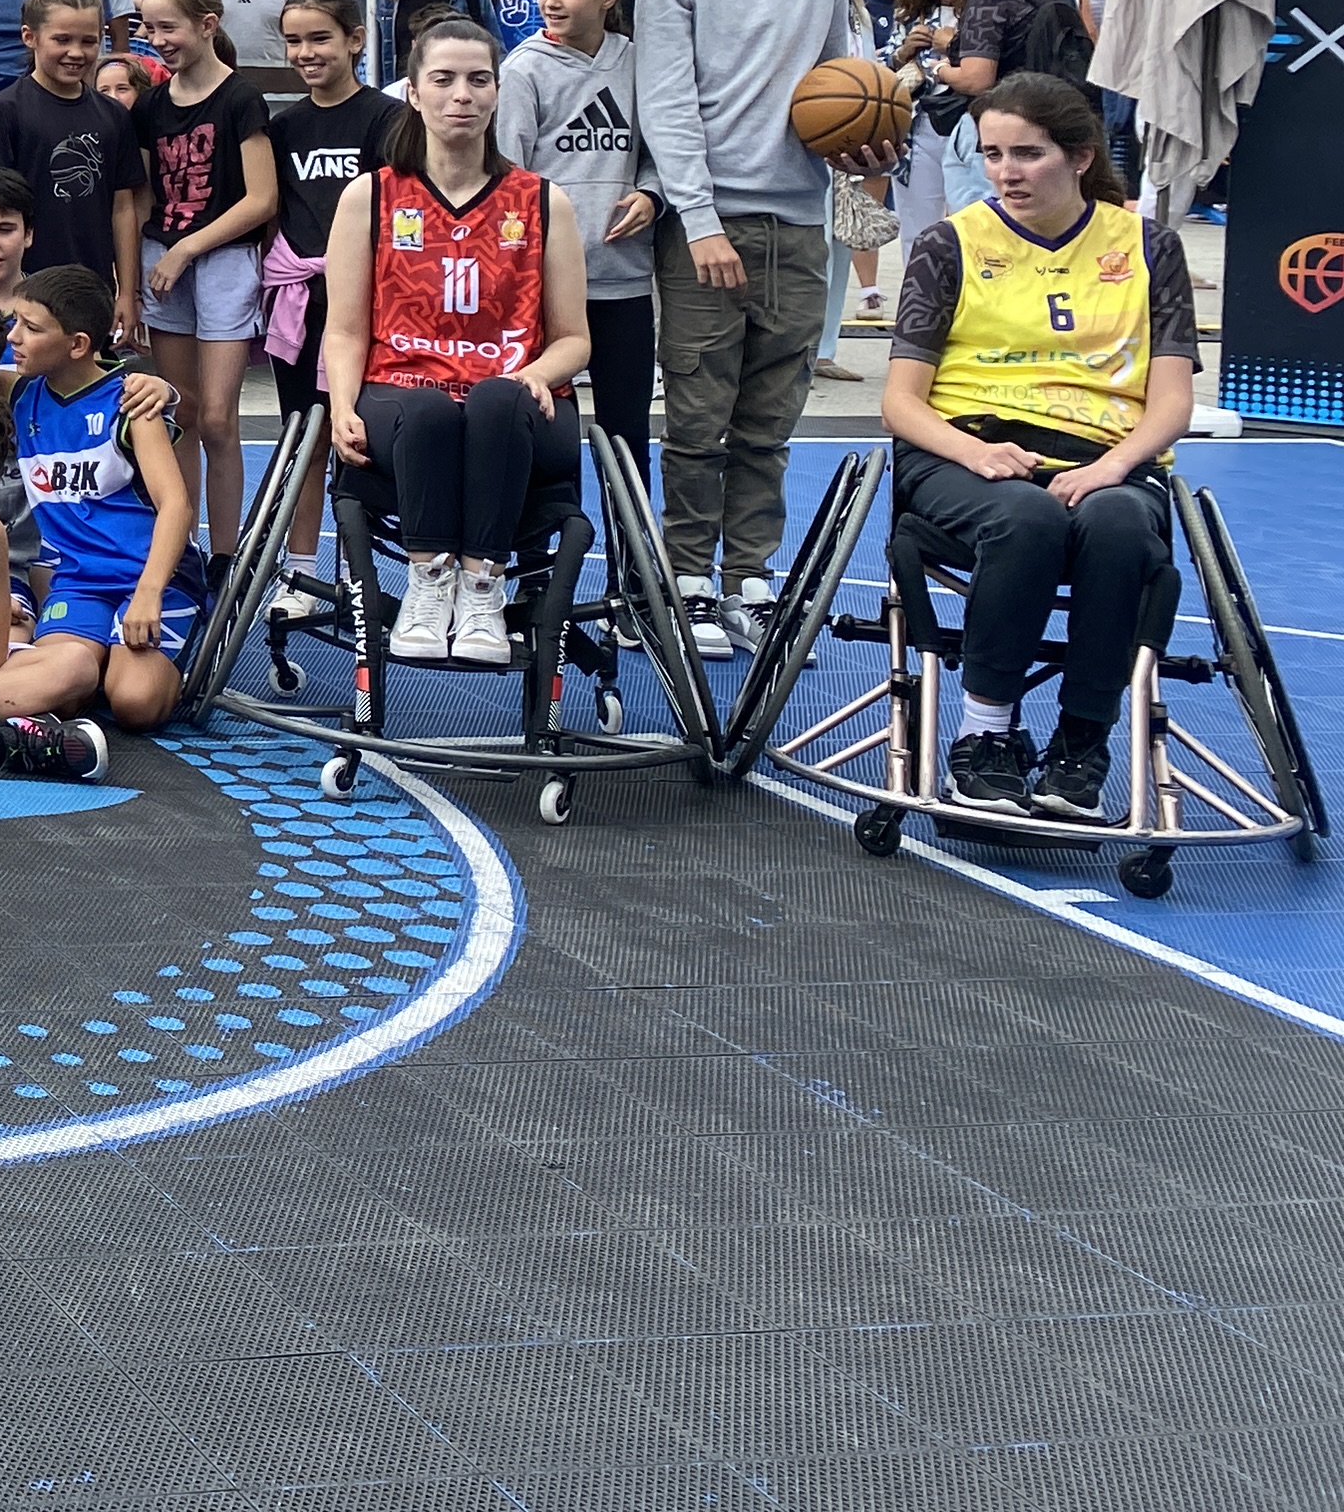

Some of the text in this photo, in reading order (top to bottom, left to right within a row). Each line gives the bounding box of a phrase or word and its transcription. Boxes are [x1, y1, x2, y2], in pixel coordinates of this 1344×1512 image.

[156, 122, 216, 176] MO
[555, 128, 633, 152] adida
[291, 148, 361, 181] VANS
[441, 257, 480, 315] 10
[1047, 292, 1076, 331] 6
[390, 372, 475, 398] ORTOPED
[85, 411, 105, 436] 10
[42, 601, 68, 624] 10
[351, 579, 367, 665] TARMAK
